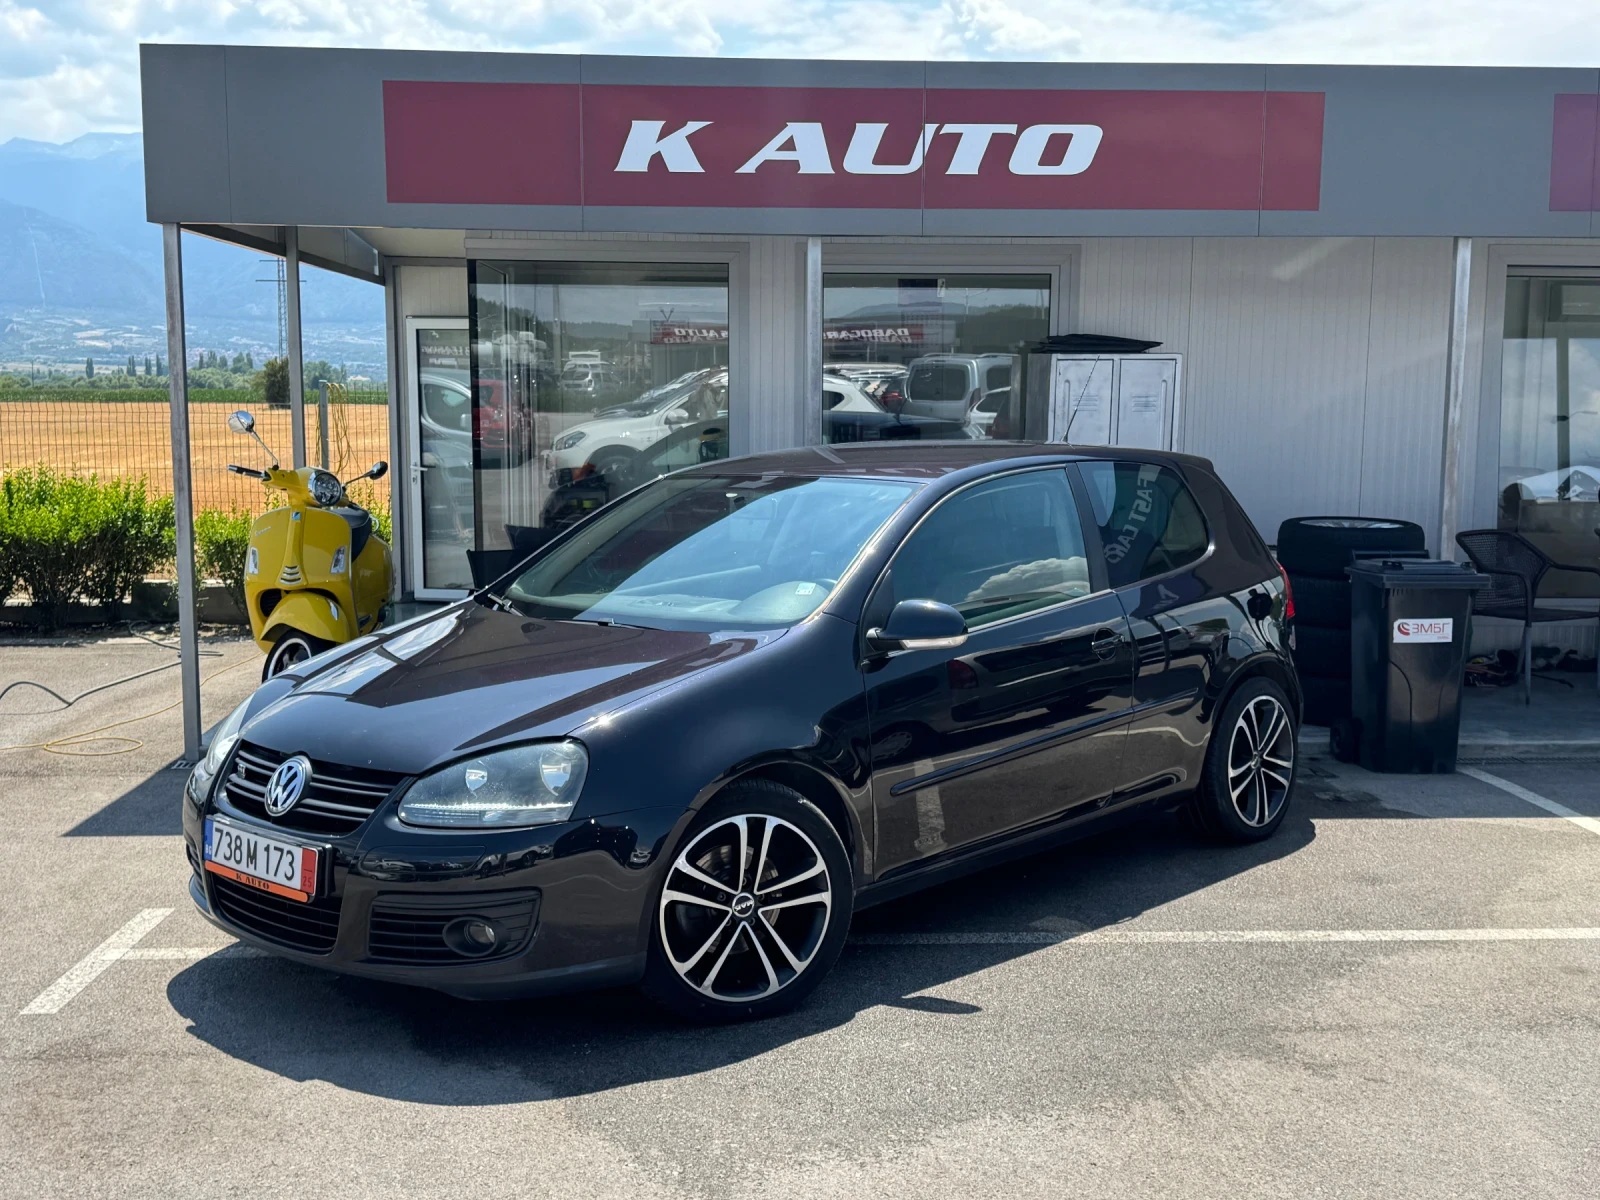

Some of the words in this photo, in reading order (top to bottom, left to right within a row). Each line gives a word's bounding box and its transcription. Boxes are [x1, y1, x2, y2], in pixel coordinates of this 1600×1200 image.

[613, 120, 714, 173] K
[734, 121, 1104, 176] AUTO
[1411, 622, 1450, 634] ЗМБГ
[236, 872, 242, 880] K
[245, 876, 270, 890] AUTO
[302, 876, 312, 888] 25
